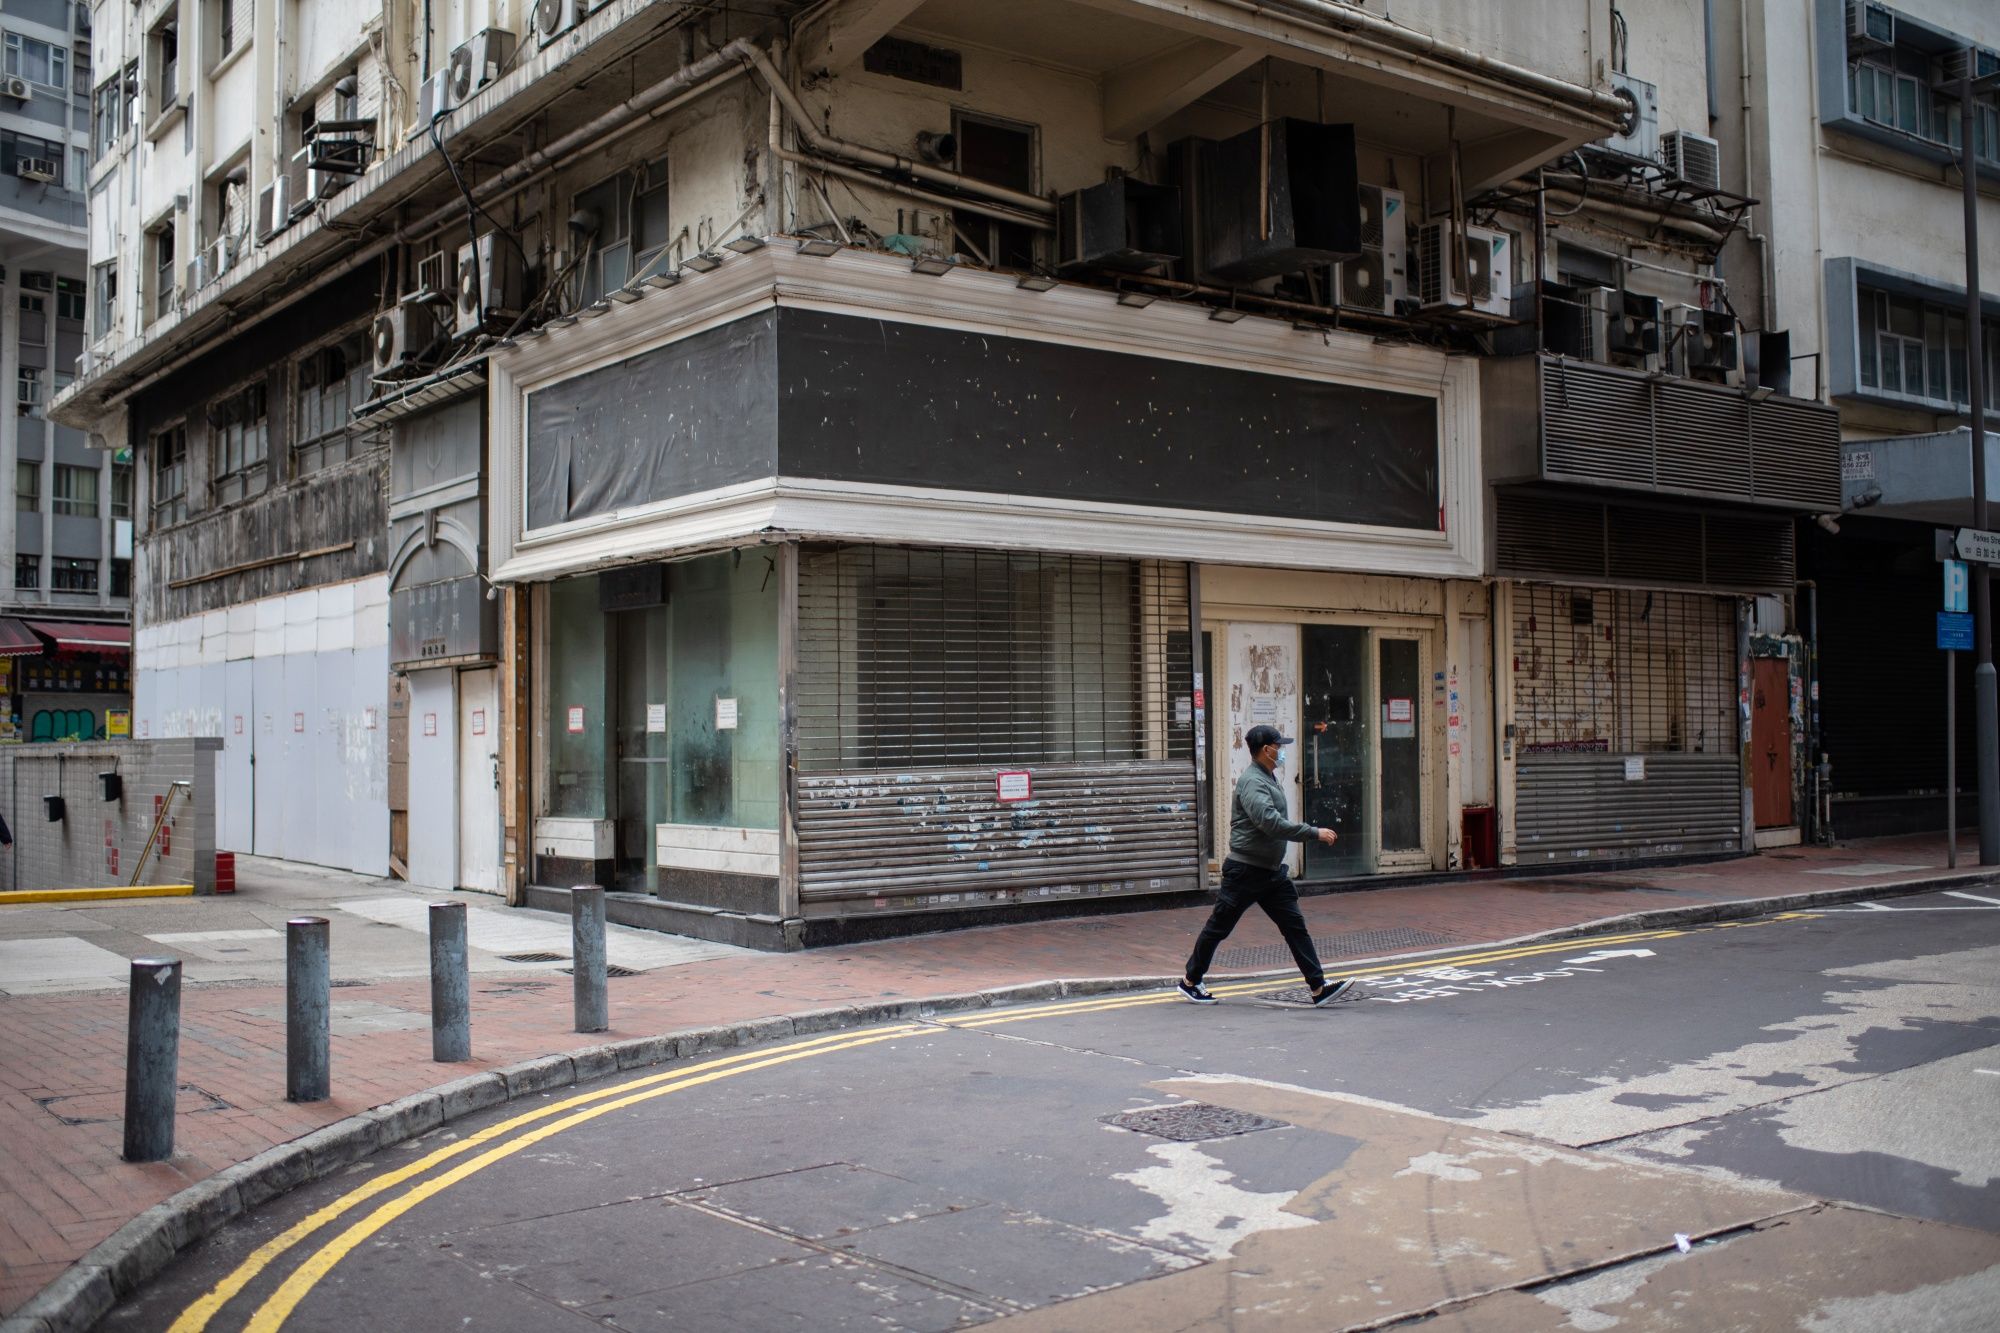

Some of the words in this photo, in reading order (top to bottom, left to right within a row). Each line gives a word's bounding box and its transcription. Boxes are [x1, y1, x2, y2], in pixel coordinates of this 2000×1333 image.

[1973, 532, 1990, 543] Parkes
[1468, 967, 1605, 988] LOOK
[1370, 985, 1484, 1003] LEFT
